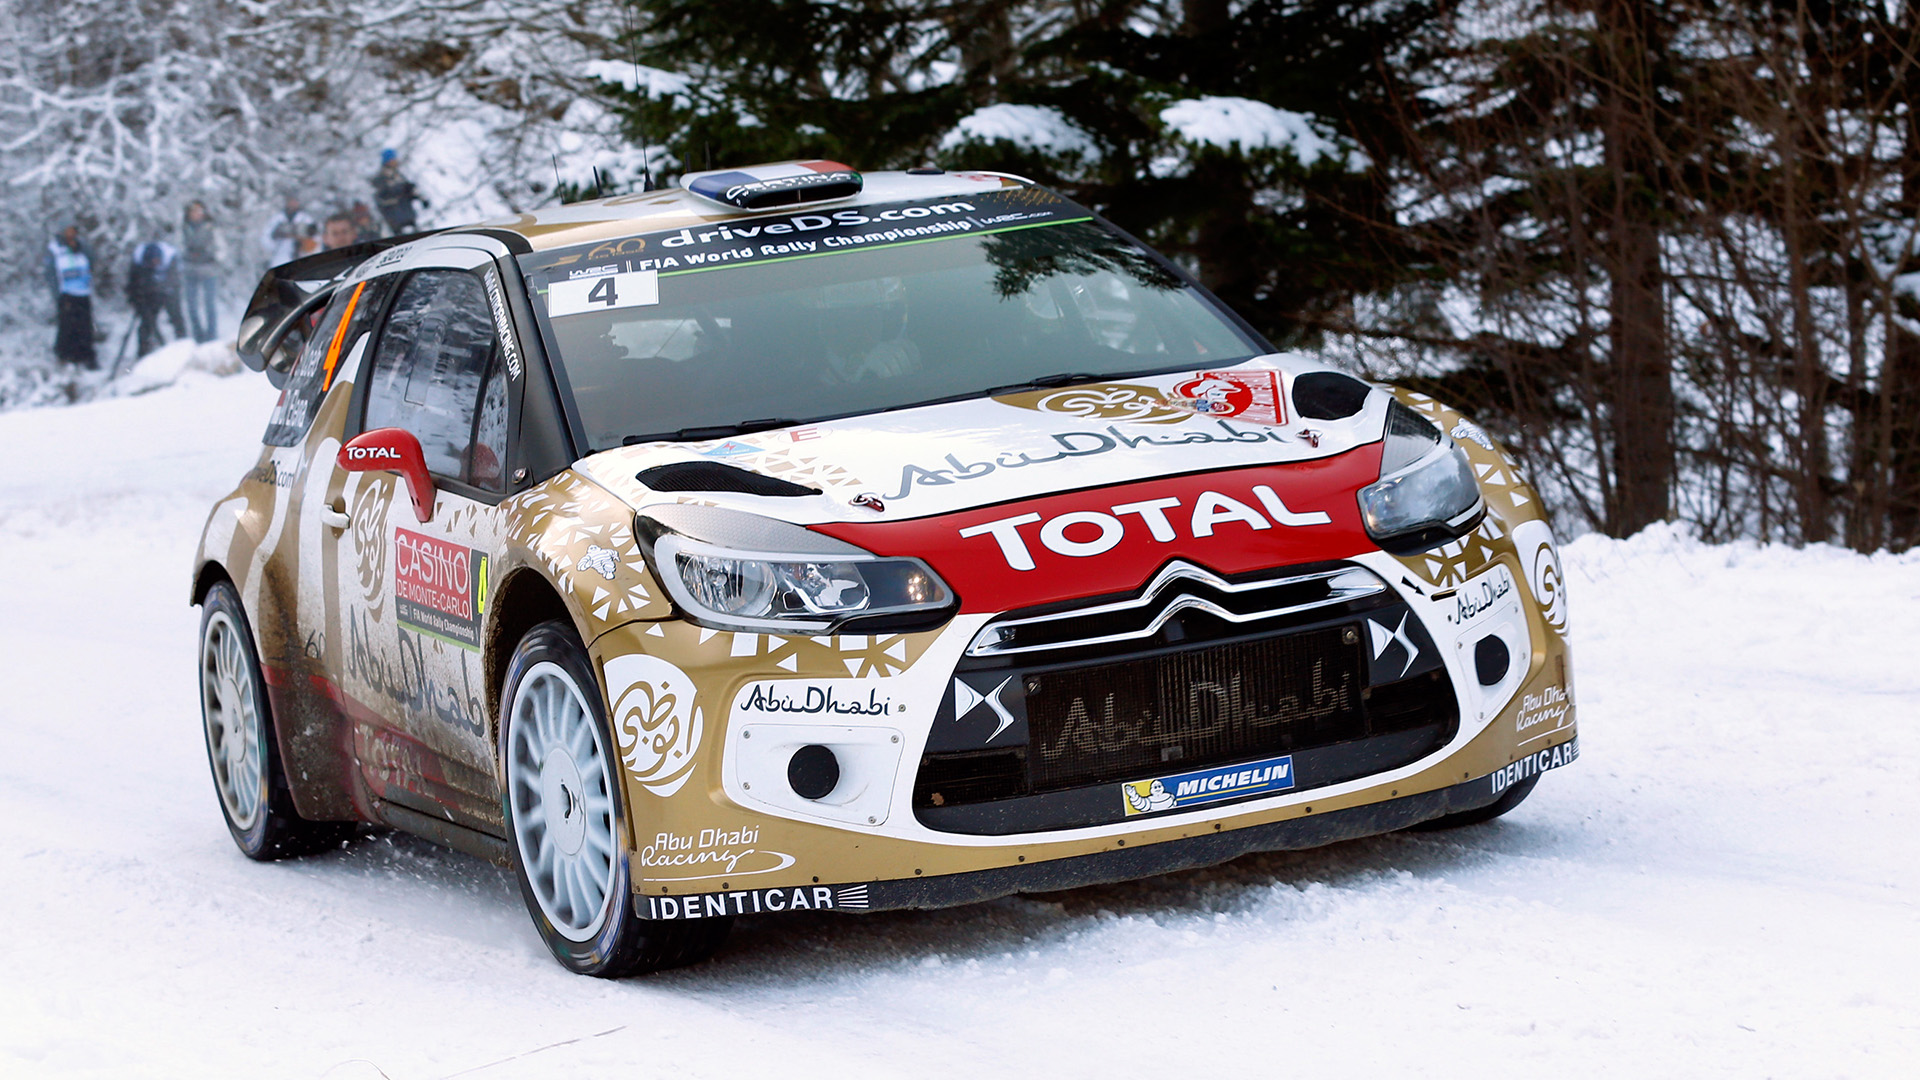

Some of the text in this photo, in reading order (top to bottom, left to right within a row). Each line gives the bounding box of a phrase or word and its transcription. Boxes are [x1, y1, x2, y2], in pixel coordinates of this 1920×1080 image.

[726, 172, 852, 200] CERTINA
[661, 201, 976, 248] driveDS.com
[639, 256, 680, 271] FIA
[684, 246, 754, 266] World
[760, 239, 817, 256] Rally
[822, 218, 973, 247] Championship
[587, 276, 619, 307] 4
[346, 446, 402, 460] TOTAL
[957, 483, 1333, 572] TOTAL
[396, 533, 469, 595] CASINO
[397, 578, 409, 598] DE
[408, 582, 470, 619] MONTE-CARLO
[443, 619, 475, 642] Championship
[1176, 763, 1290, 797] MICHELIN
[1491, 741, 1574, 795] IDENTICAR
[654, 825, 760, 851] Abu Dhabi
[641, 846, 756, 874] Racing
[648, 886, 834, 921] IDENTICAR
